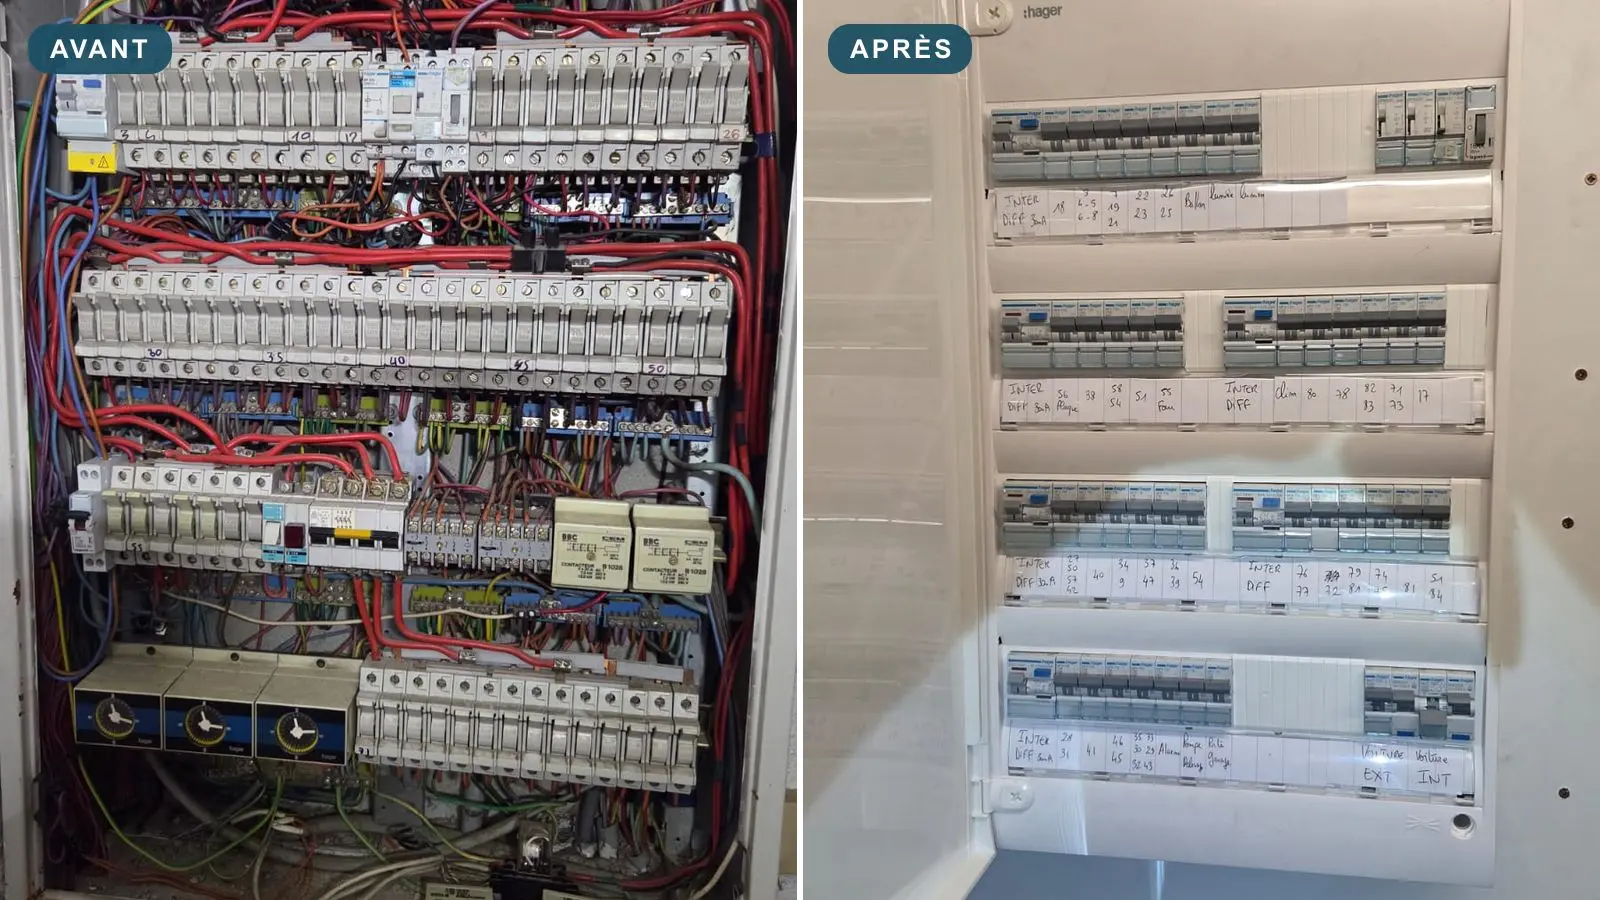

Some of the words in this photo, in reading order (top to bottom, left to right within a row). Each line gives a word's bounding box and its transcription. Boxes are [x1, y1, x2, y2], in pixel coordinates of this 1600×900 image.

[120, 130, 129, 140] 3
[723, 129, 740, 140] 26
[1004, 194, 1039, 207] INTER
[1136, 191, 1149, 200] 22
[1053, 201, 1065, 214] 18
[1108, 202, 1120, 212] 19
[1161, 207, 1173, 218] 25
[1134, 208, 1148, 219] 23
[1108, 217, 1119, 227] 21
[266, 351, 284, 363] 35
[648, 364, 665, 373] 50
[1008, 382, 1044, 395] INTER
[1225, 381, 1259, 394] INTER
[1335, 387, 1350, 400] 78
[1135, 390, 1147, 401] 51
[1418, 389, 1429, 403] 17
[1110, 398, 1121, 408] 54
[1389, 400, 1404, 411] 73
[561, 533, 578, 542] BBC
[561, 561, 595, 569] CONTACTEUR
[1016, 557, 1051, 570] INTER
[1249, 560, 1281, 573] INTER
[1296, 565, 1308, 578] 76
[1348, 566, 1361, 578] 79
[1171, 576, 1180, 589] 39
[1192, 571, 1204, 589] 54
[1017, 729, 1050, 745] INTER
[1364, 768, 1392, 783] EXT
[1418, 770, 1451, 787] INT
